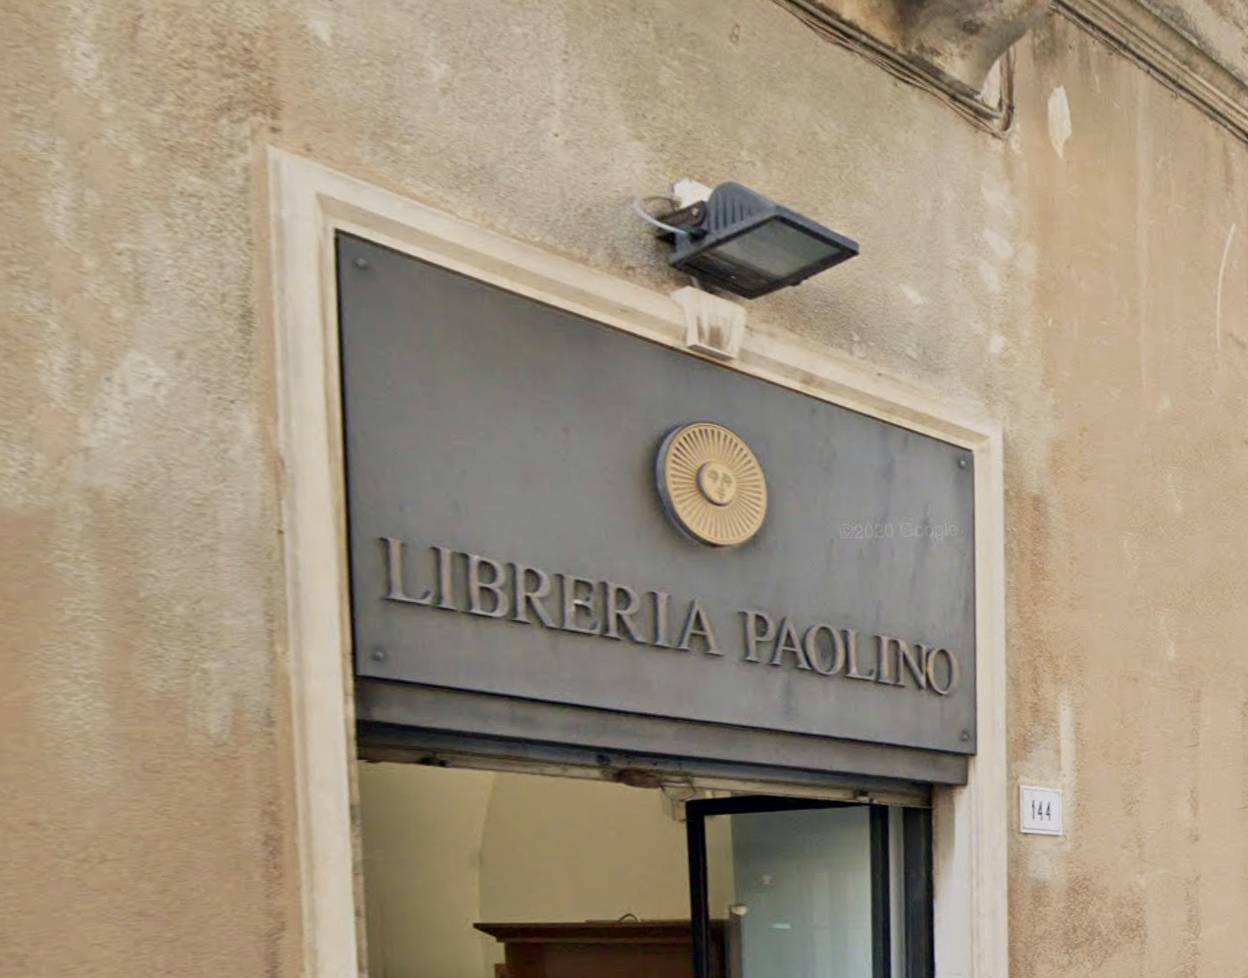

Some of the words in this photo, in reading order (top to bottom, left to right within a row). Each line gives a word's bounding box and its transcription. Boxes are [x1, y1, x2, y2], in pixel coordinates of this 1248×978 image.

[378, 536, 723, 656] LIBRERIA
[742, 609, 960, 696] PAOLINO
[1031, 800, 1051, 820] 144
